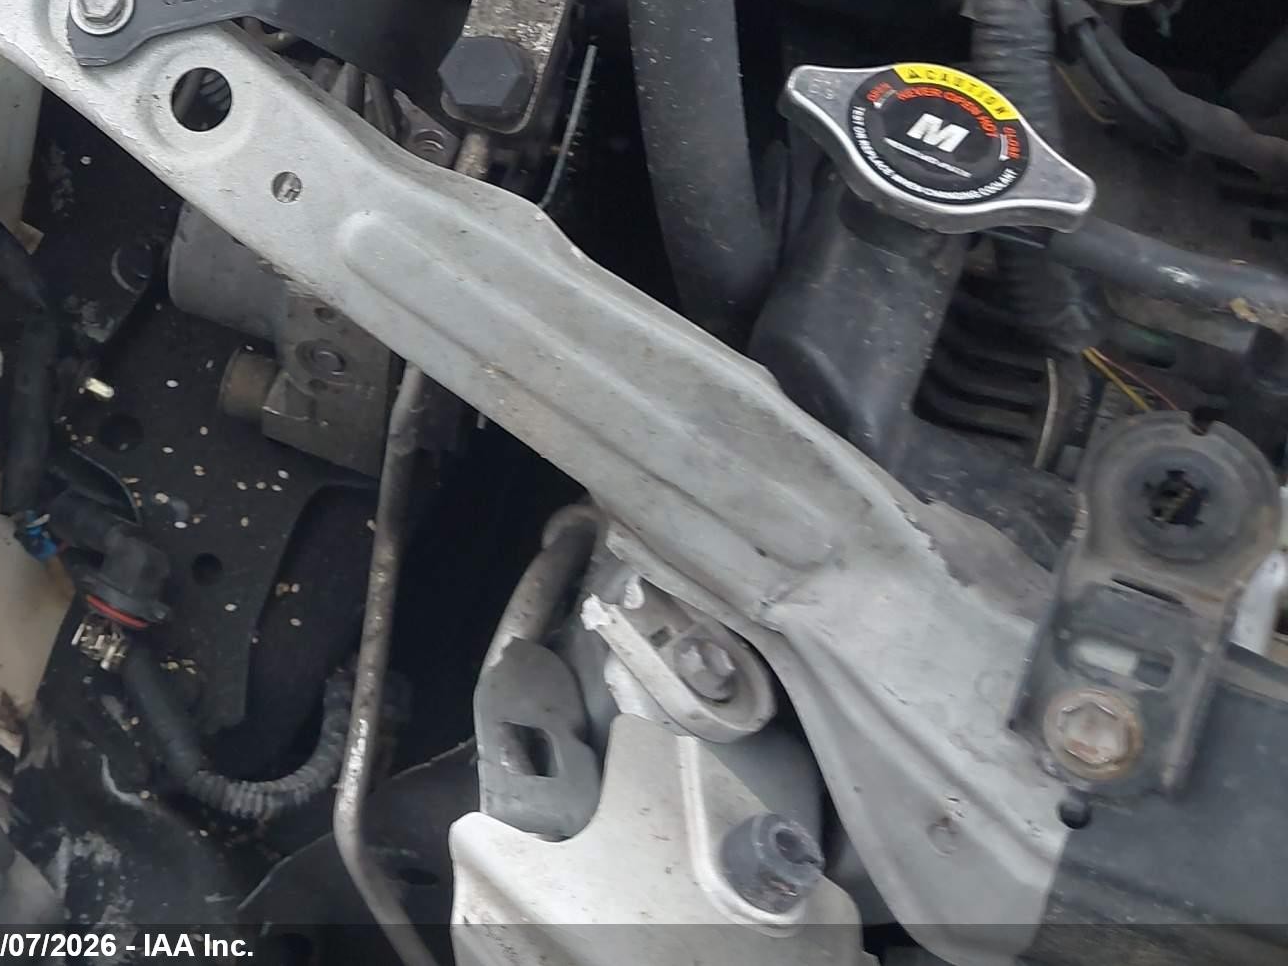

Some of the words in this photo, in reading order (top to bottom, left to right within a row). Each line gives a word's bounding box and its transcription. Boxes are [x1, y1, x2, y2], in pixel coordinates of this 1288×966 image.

[896, 86, 942, 102] NEVER
[926, 70, 1009, 115] CAUTION
[906, 113, 971, 153] M
